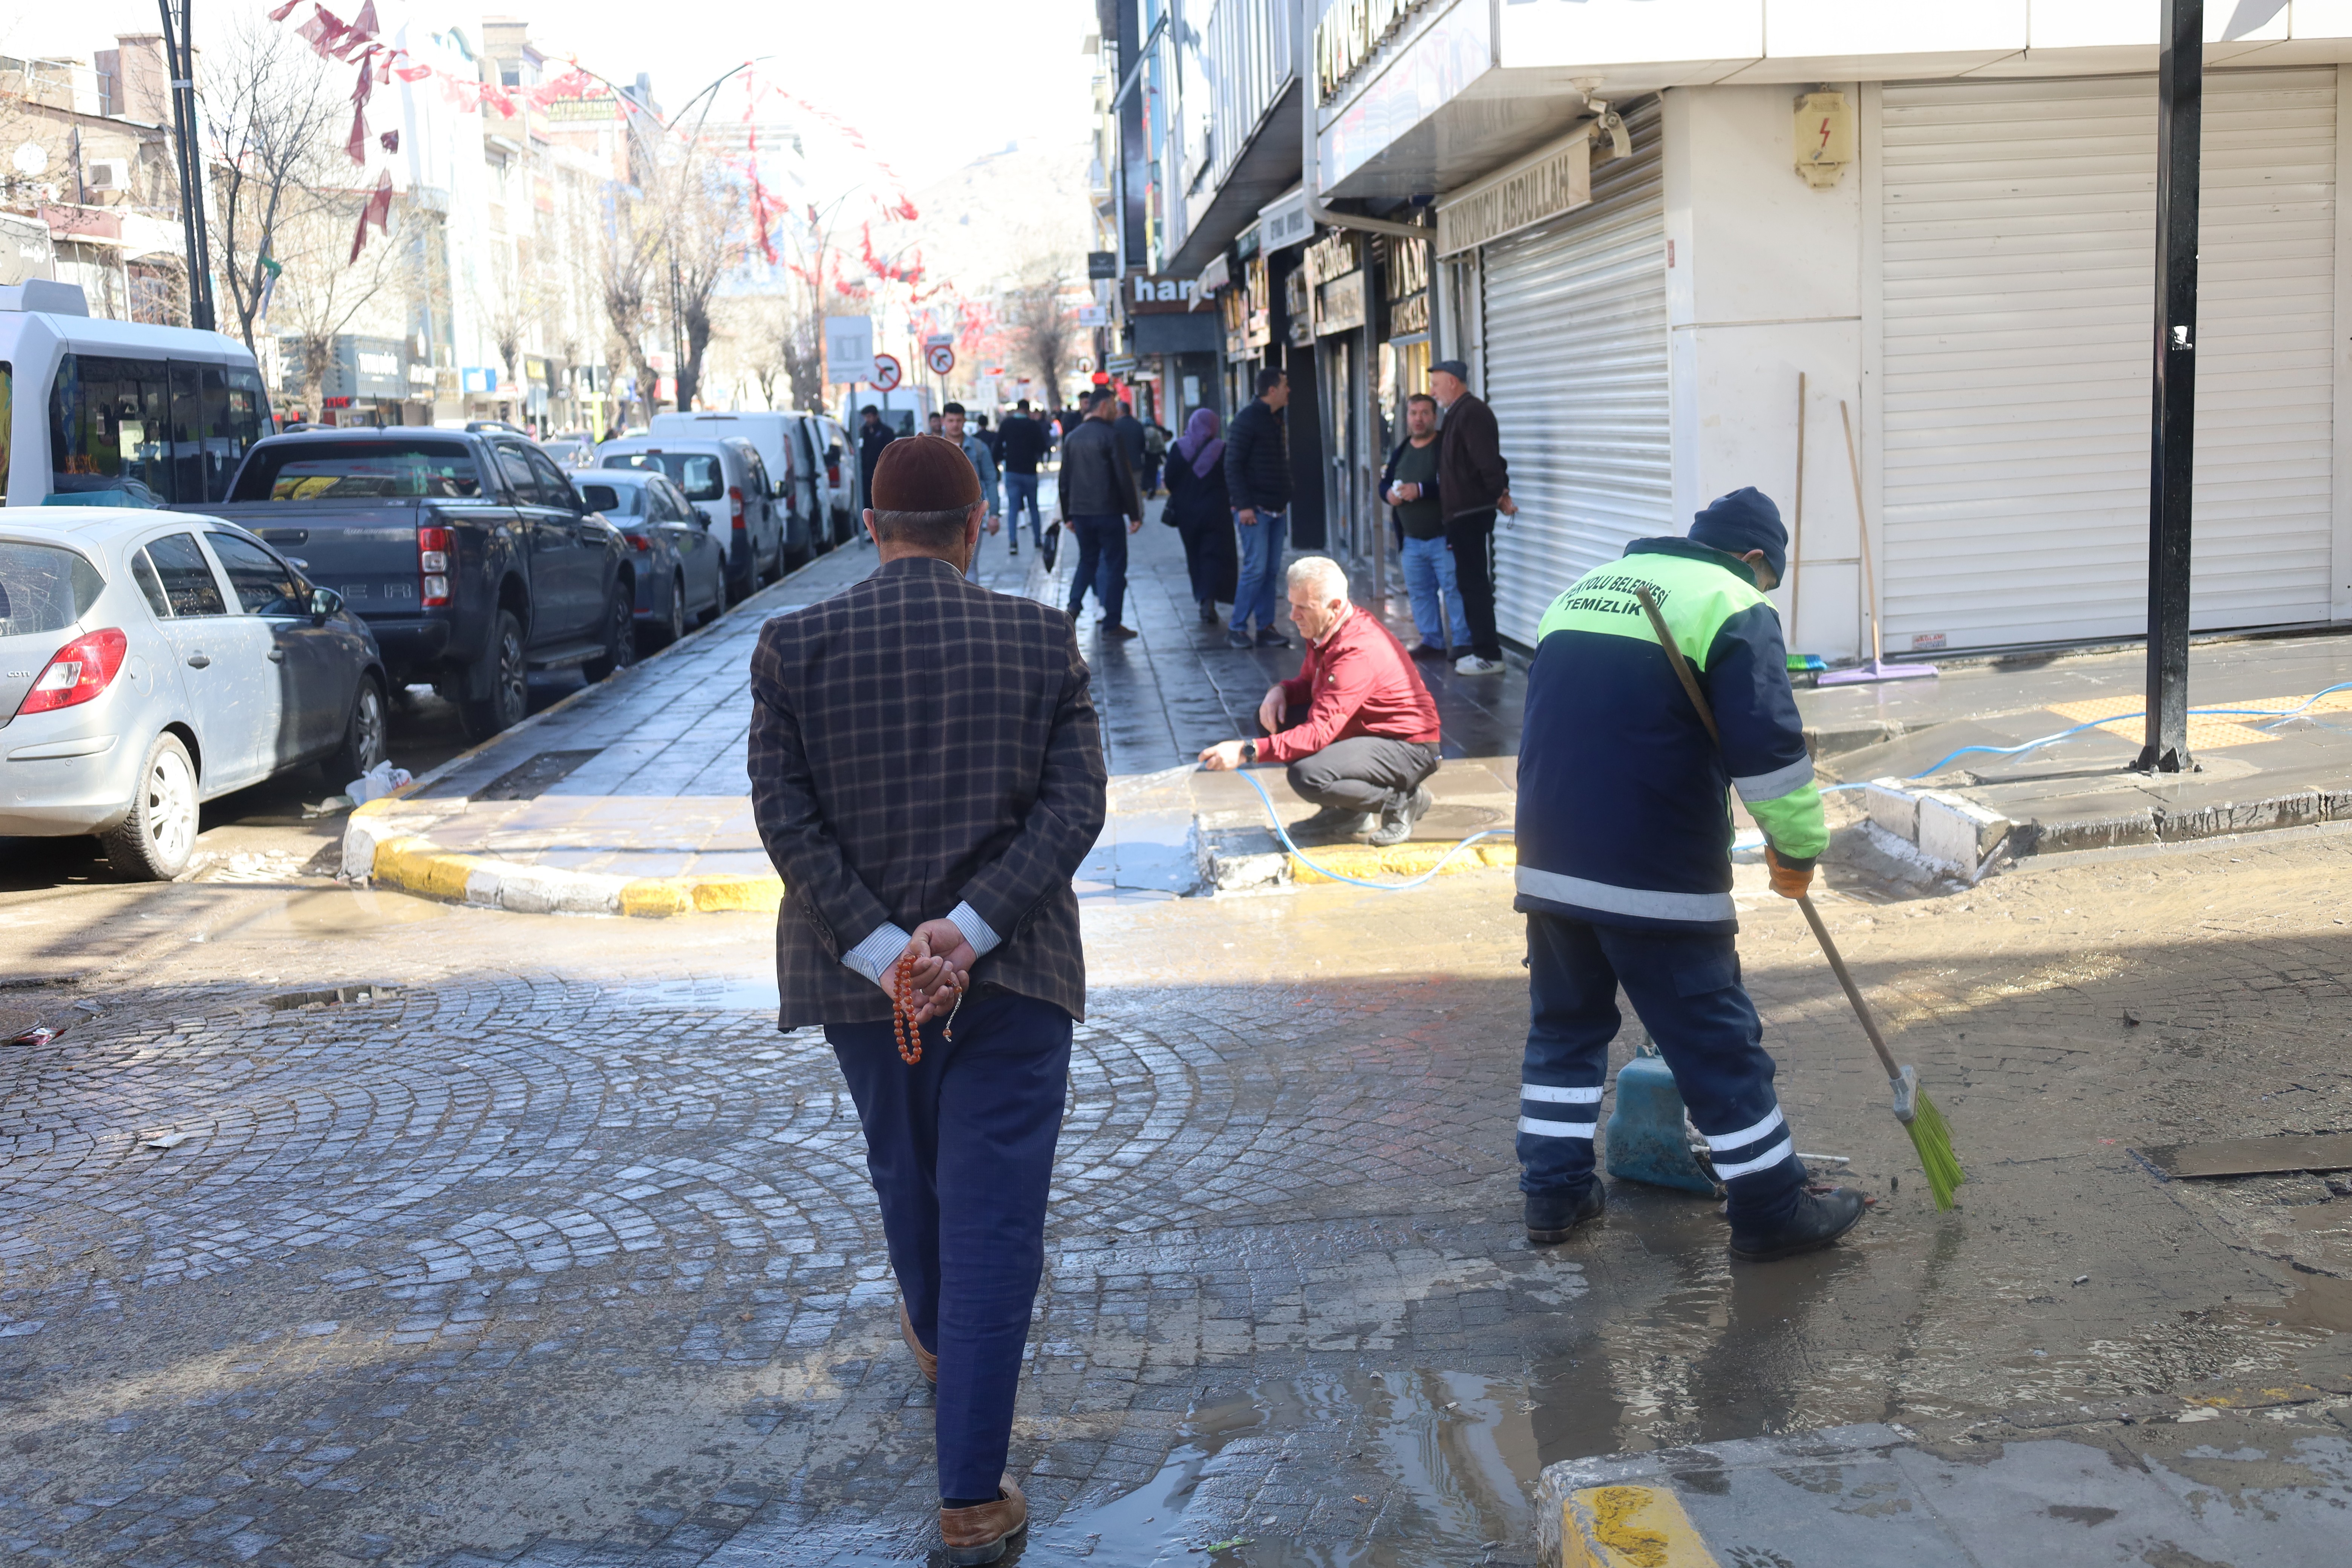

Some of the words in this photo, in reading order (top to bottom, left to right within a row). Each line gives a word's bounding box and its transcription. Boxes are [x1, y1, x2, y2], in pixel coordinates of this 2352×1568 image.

[1448, 188, 1498, 250] KUYUMCU
[1502, 155, 1569, 231] ABDULLAH
[1564, 597, 1643, 616] TEMİZLİK
